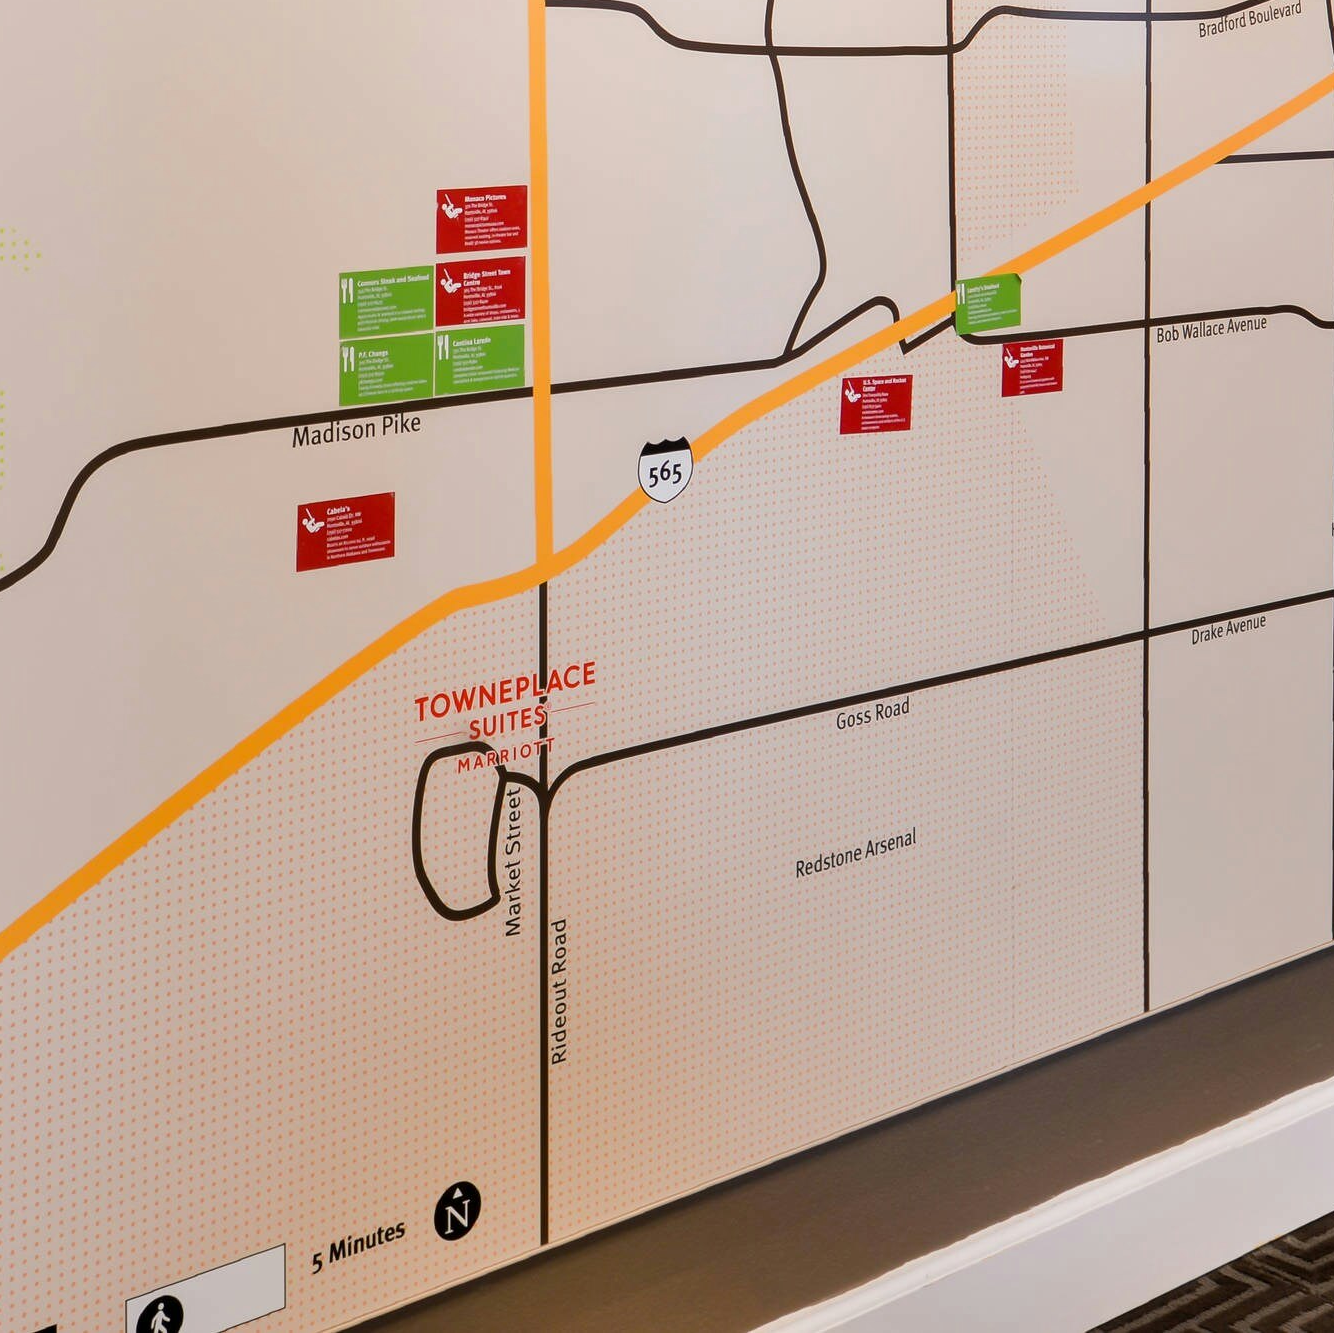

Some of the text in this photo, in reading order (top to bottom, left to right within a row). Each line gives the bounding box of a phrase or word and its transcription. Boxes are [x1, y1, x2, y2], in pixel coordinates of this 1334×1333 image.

[1198, 14, 1247, 39] Bradford
[1156, 316, 1267, 344] Bob Wallace Avenue
[292, 413, 421, 448] Madison Pike
[649, 459, 682, 488] 565
[1190, 615, 1267, 646] Drake Avenue
[414, 661, 596, 722] TOWNEPLACE
[836, 696, 910, 731] Goss Road
[457, 737, 555, 774] MARRIOTT
[505, 786, 521, 937] Market Street
[795, 826, 918, 880] Redstone Arsenal
[551, 918, 567, 1066] Rideout Road
[443, 1199, 470, 1235] N
[312, 1221, 406, 1275] 5 Minutes
